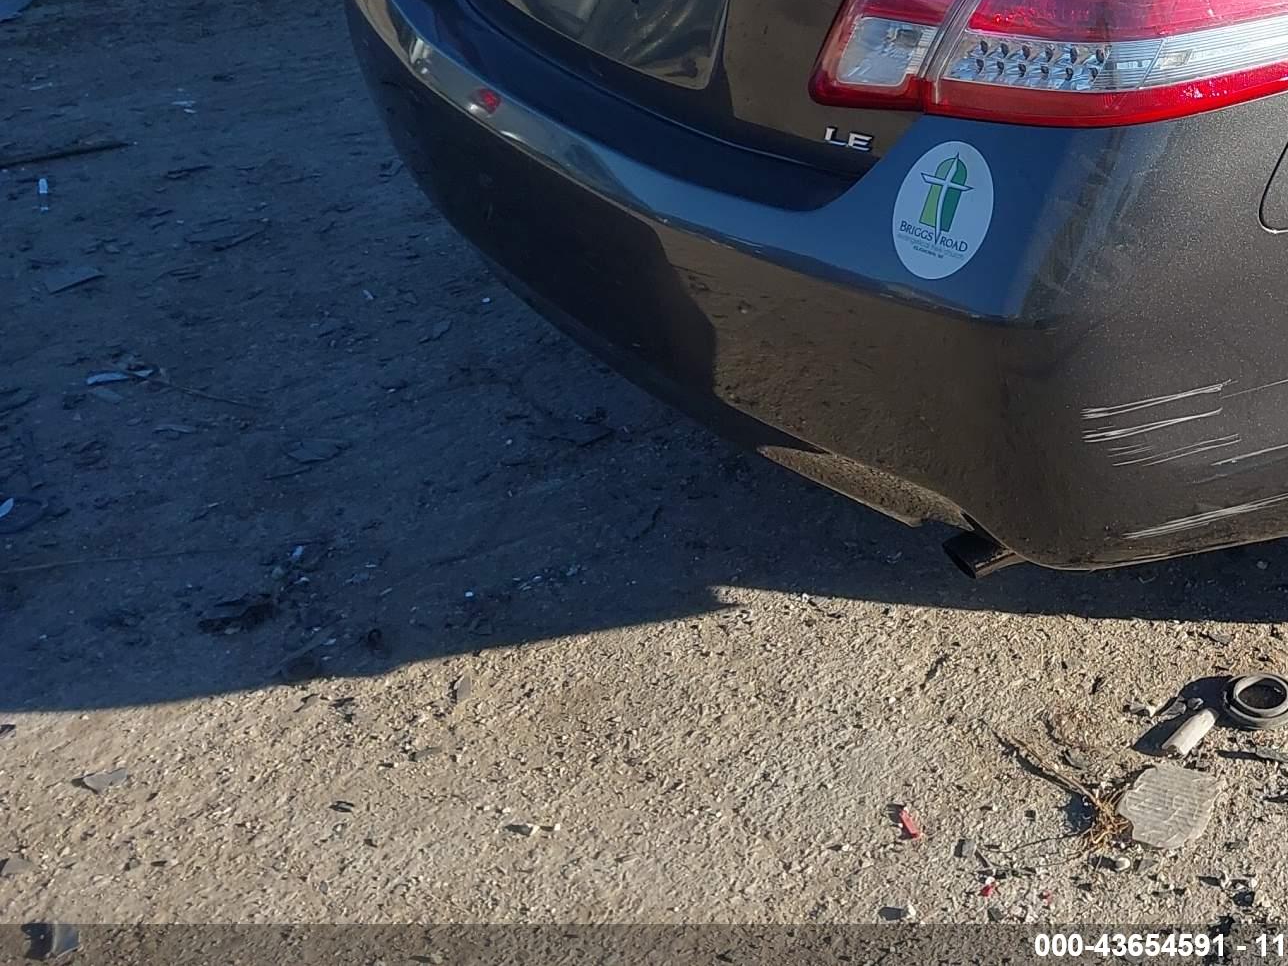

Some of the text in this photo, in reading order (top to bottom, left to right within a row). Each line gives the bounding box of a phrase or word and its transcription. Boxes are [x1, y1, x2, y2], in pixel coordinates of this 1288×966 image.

[824, 126, 873, 152] LE
[900, 220, 934, 242] BRIGGS
[940, 236, 969, 252] ROAD
